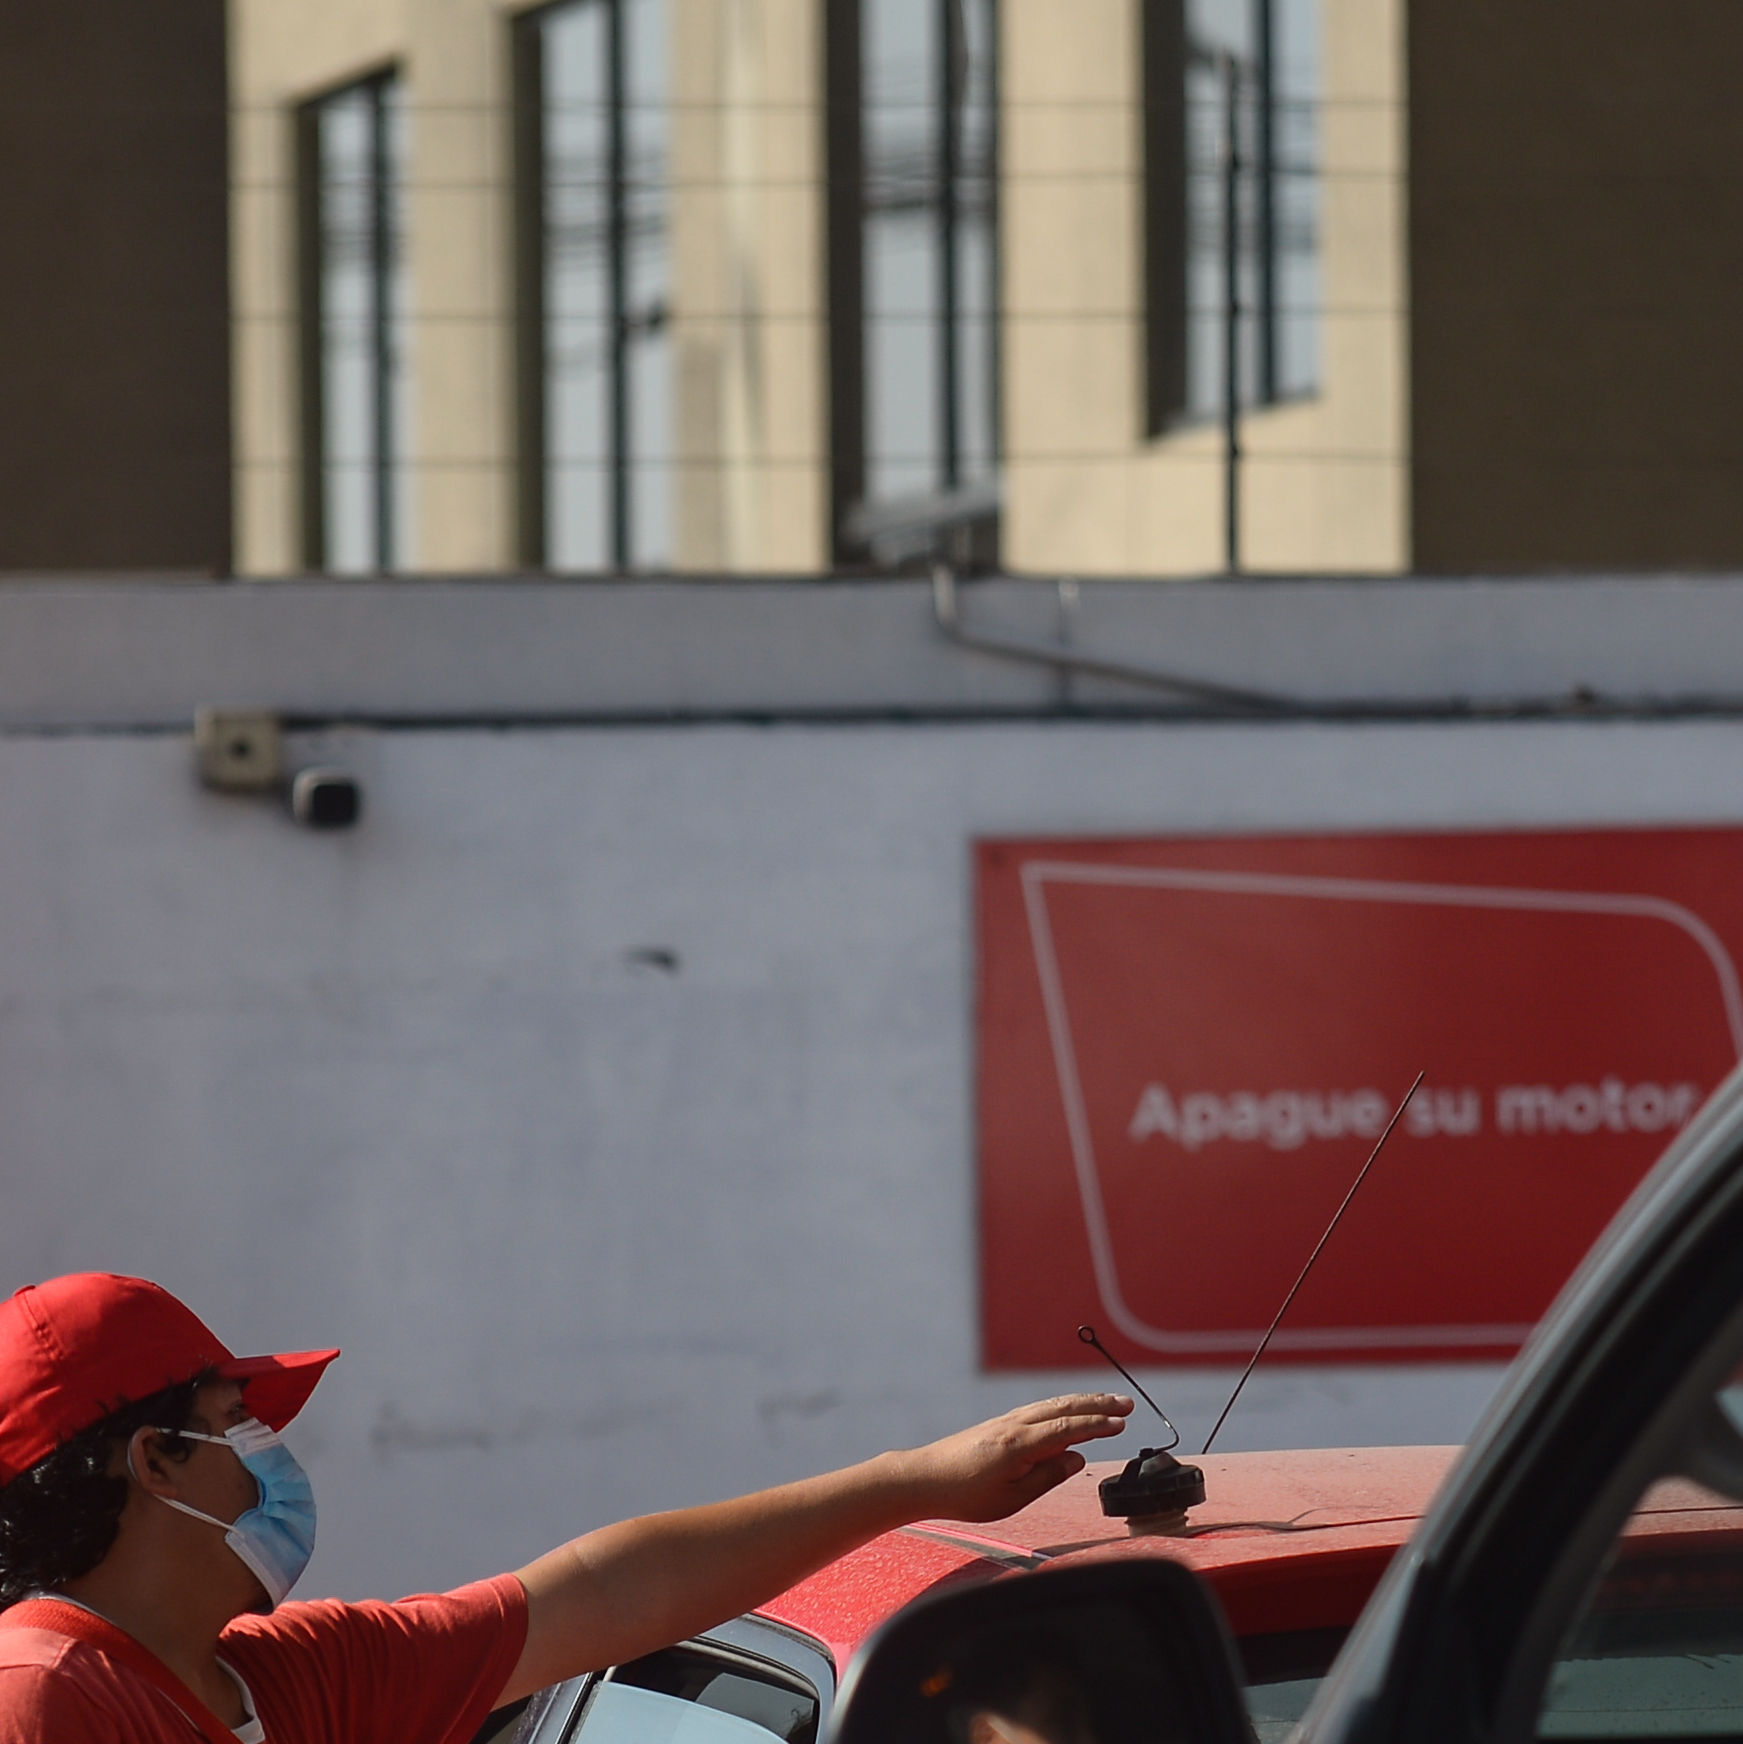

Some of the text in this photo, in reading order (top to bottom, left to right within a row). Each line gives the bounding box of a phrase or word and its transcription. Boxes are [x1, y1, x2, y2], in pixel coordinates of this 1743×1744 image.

[1126, 1075, 1696, 1153] Apague su motor
